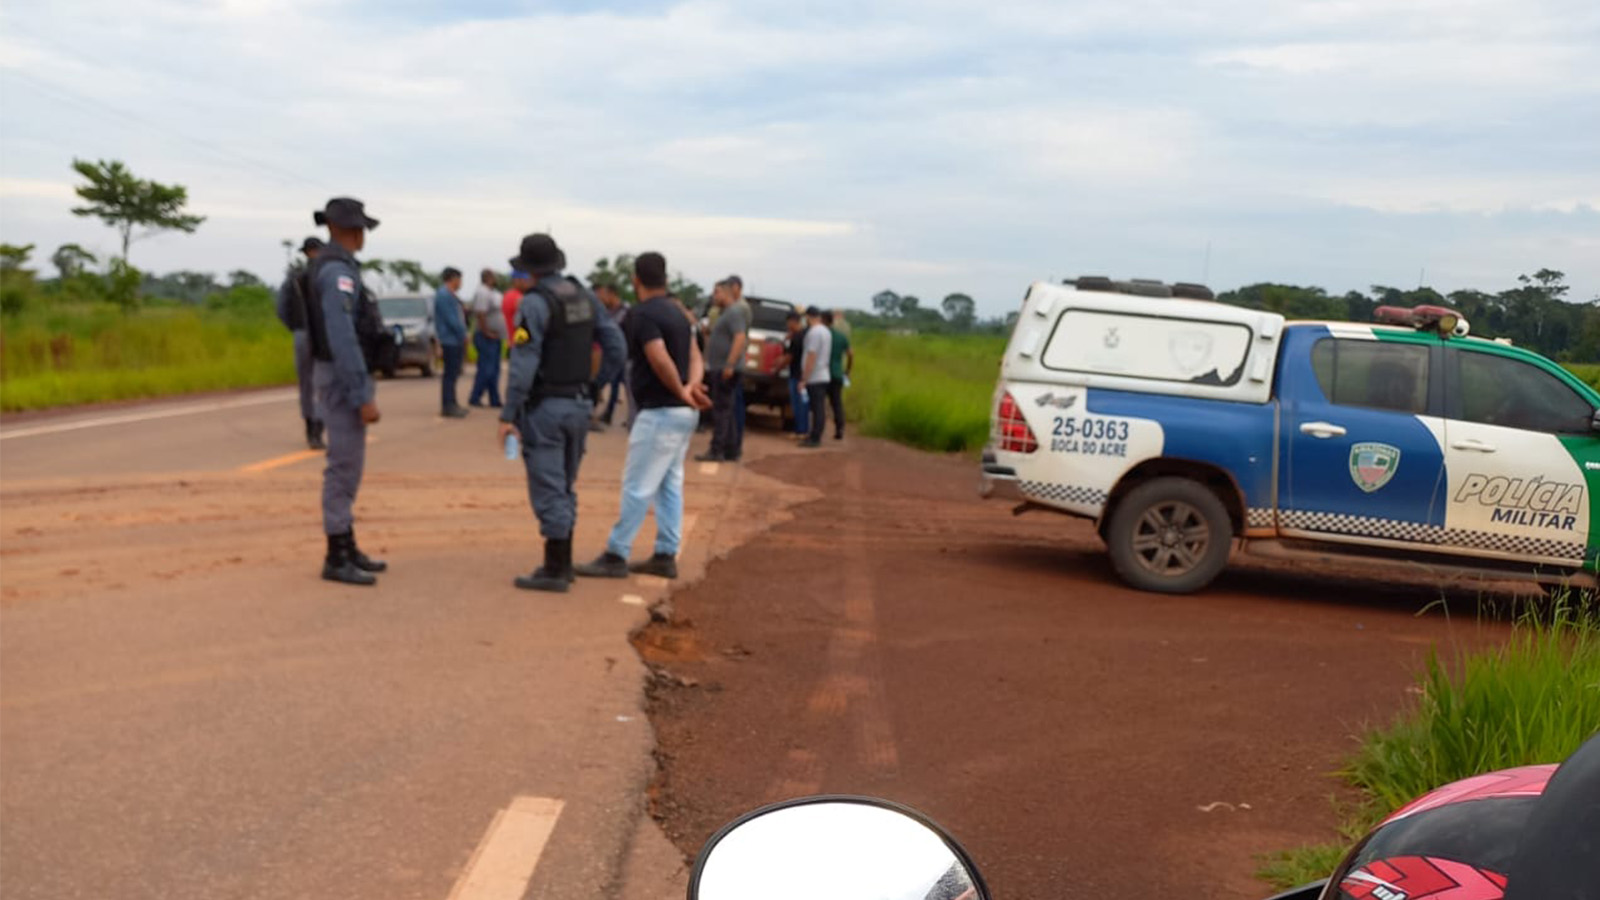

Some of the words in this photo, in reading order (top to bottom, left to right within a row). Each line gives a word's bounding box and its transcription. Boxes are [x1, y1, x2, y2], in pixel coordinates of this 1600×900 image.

[1052, 416, 1129, 441] 25-0363
[1051, 439, 1079, 453] BOCA
[1082, 440, 1097, 454] DO
[1099, 442, 1127, 457] ACRE
[1453, 473, 1584, 515] POLÍCIA
[1490, 507, 1577, 531] MILITAR
